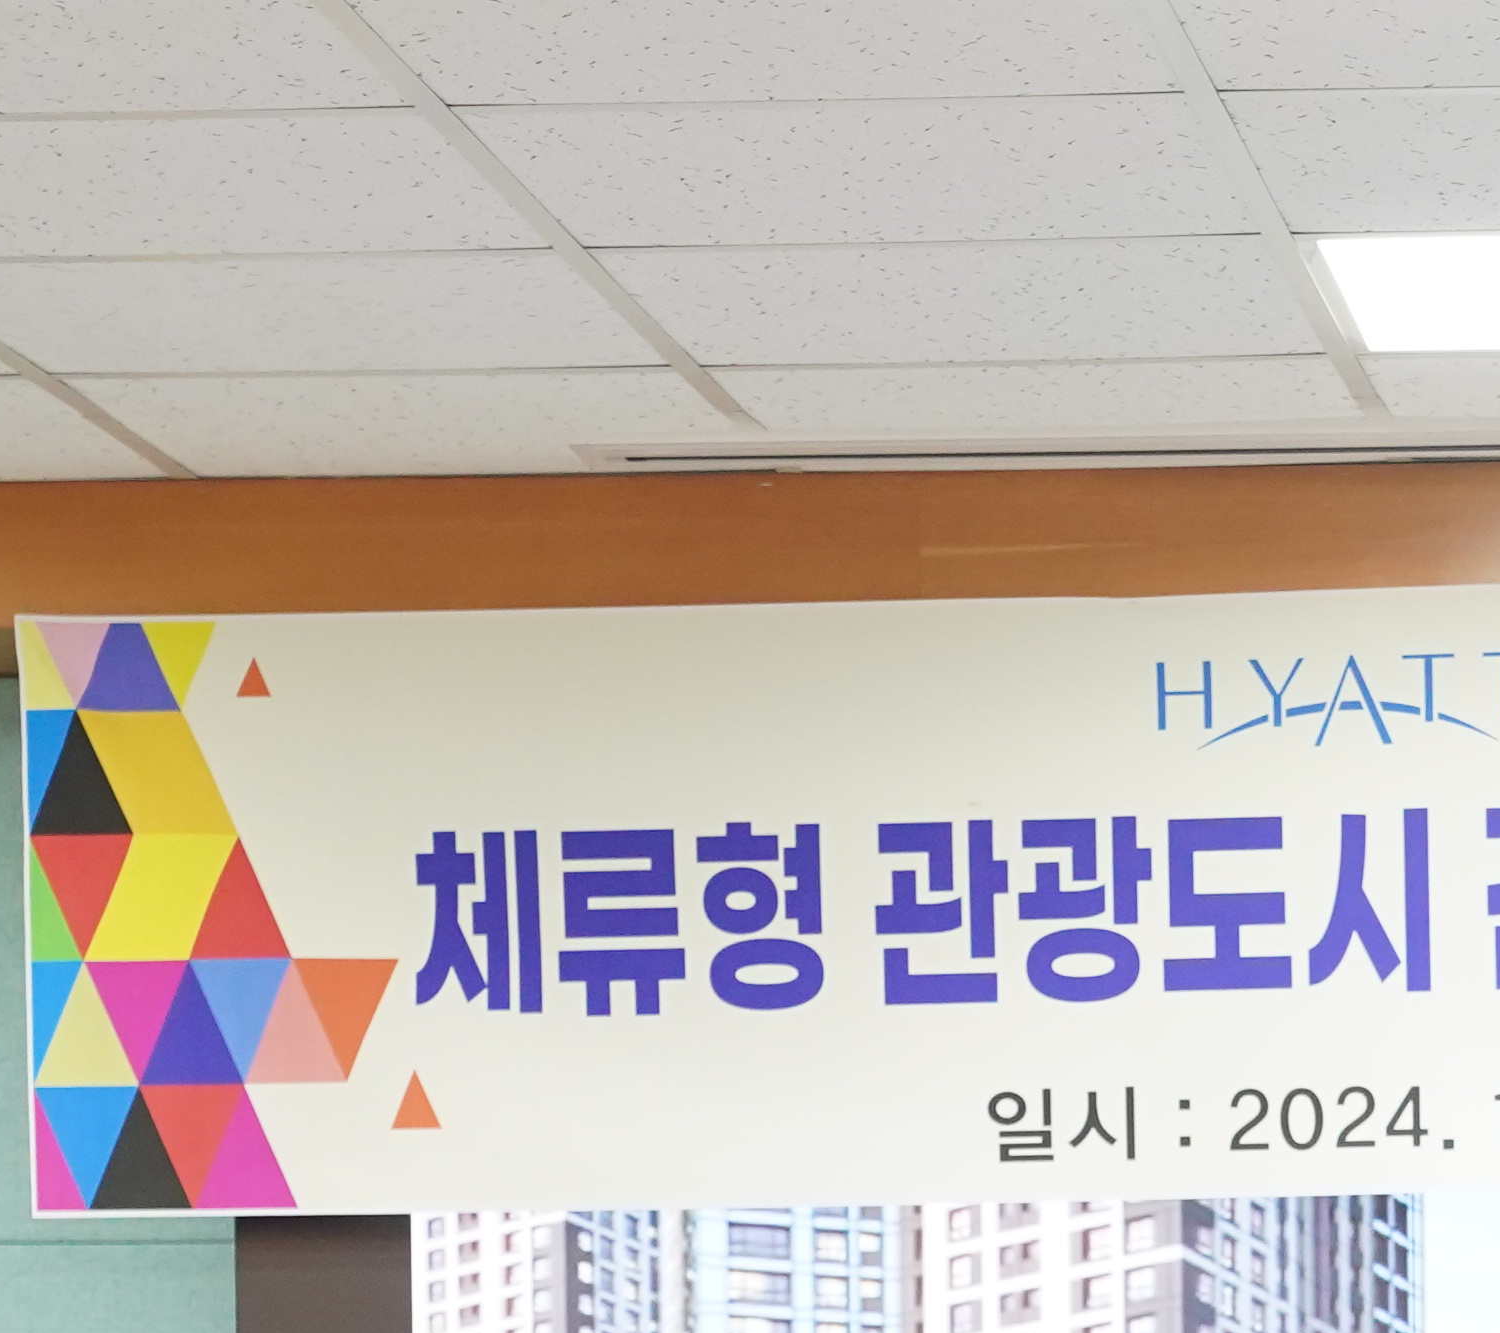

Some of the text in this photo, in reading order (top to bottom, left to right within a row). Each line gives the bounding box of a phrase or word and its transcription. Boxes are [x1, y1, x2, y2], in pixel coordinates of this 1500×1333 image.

[415, 821, 824, 1016] 체류형
[874, 808, 1431, 1005] 관광도시
[986, 1086, 1136, 1162] 일시
[1230, 1086, 1454, 1151] 2024.
